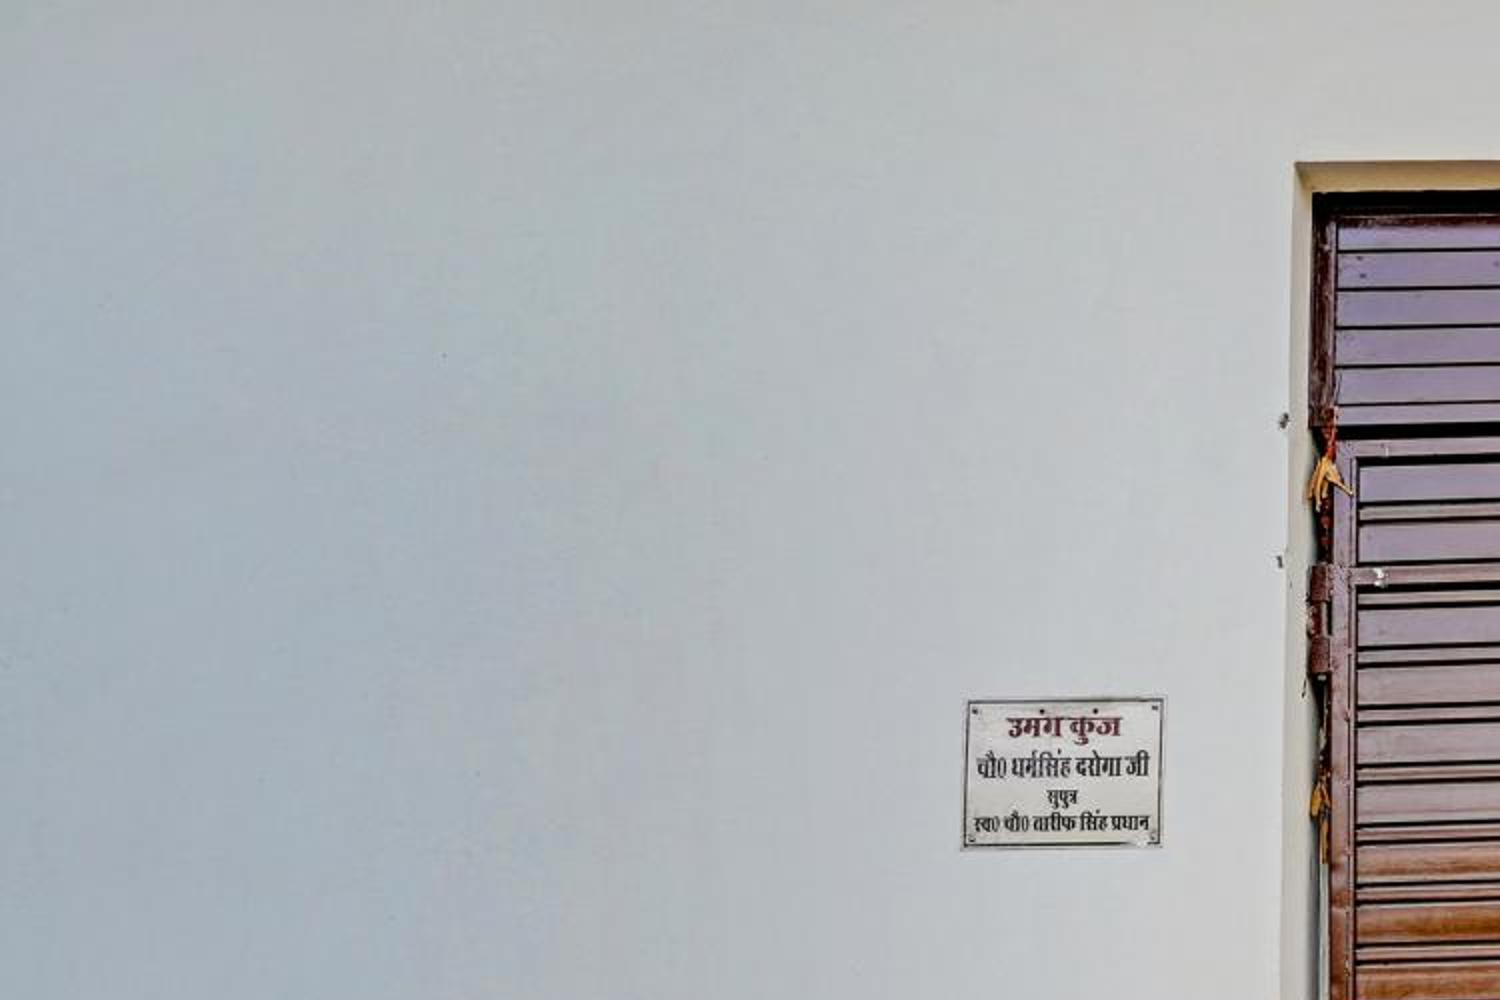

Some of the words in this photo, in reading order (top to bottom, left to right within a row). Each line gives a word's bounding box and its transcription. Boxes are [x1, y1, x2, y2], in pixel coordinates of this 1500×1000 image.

[1006, 708, 1066, 738] उमंग
[1067, 708, 1123, 745] कुंज
[1075, 750, 1121, 777] दरोगा
[1124, 750, 1151, 777] जी
[1046, 789, 1078, 809] सुपुत्र
[1033, 812, 1076, 832] तारीफ
[1080, 809, 1108, 832] सिंह
[1111, 815, 1150, 832] प्रधान
